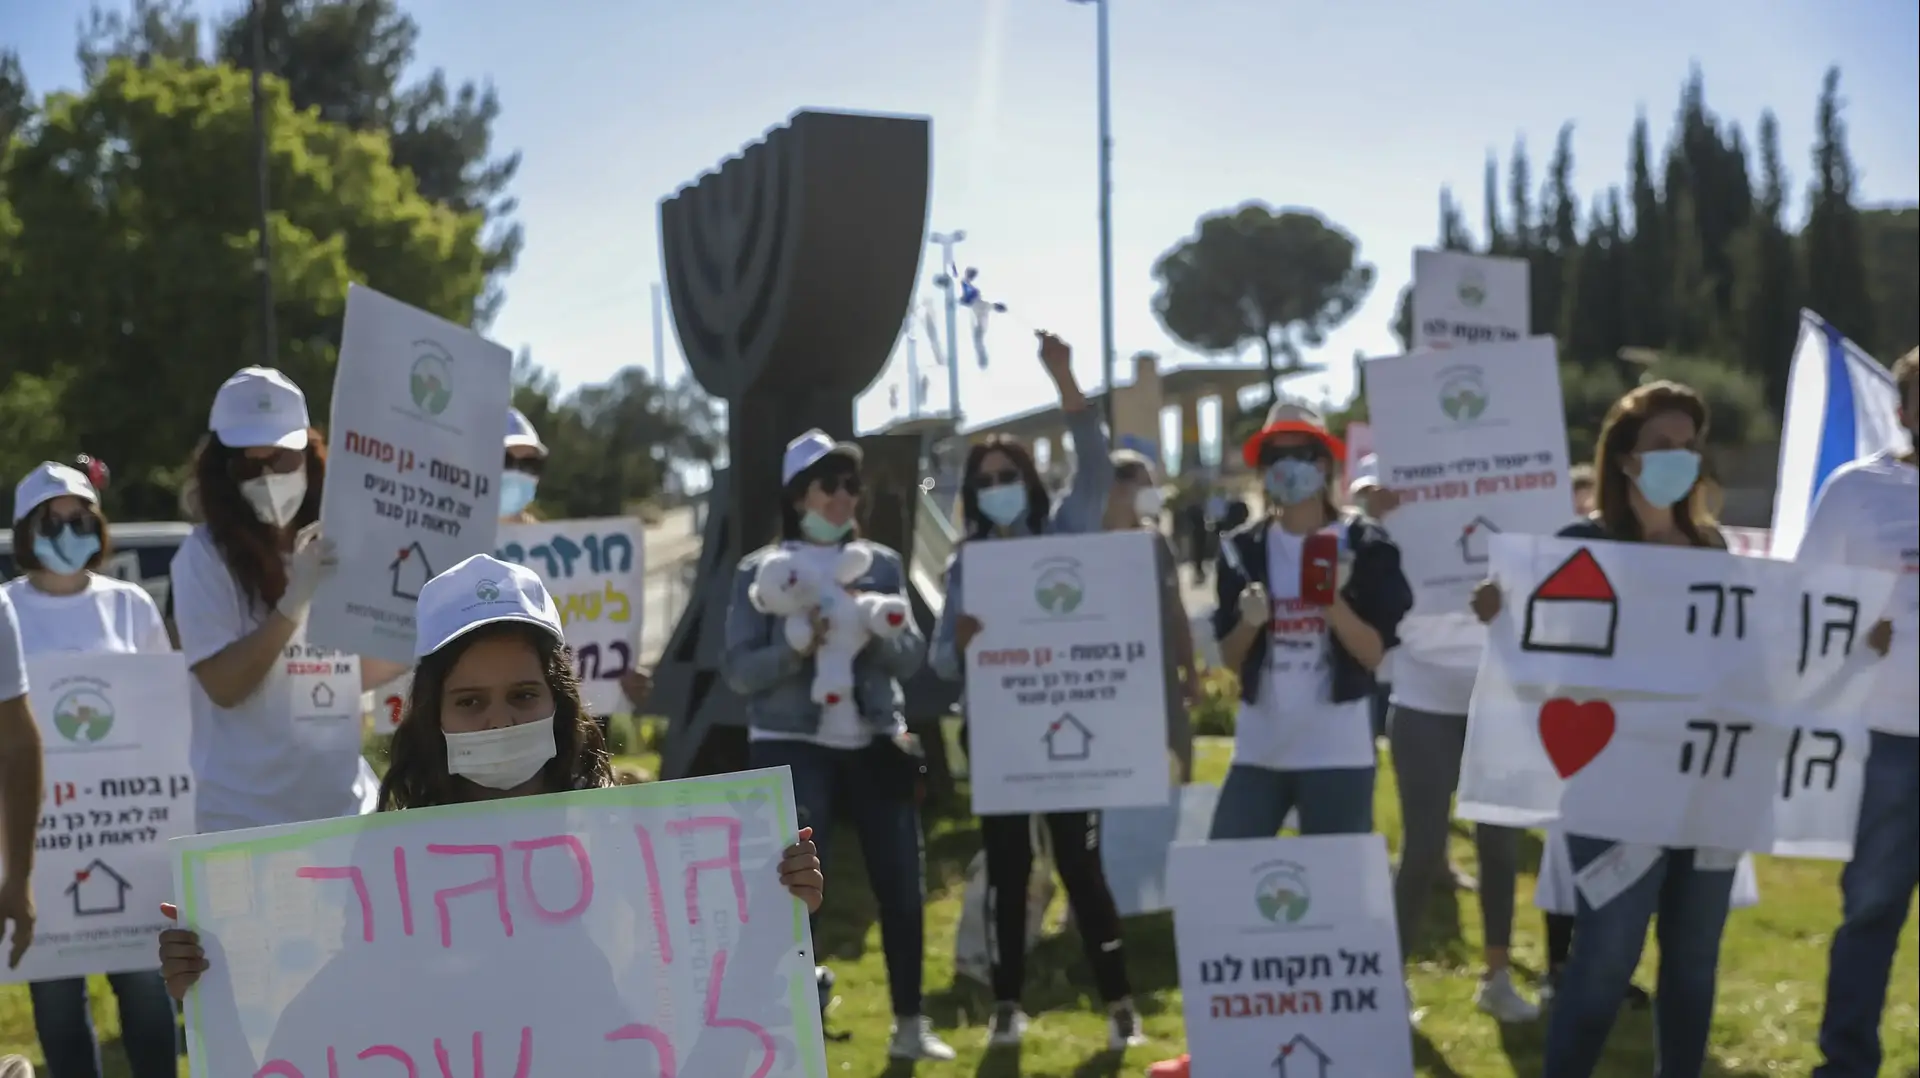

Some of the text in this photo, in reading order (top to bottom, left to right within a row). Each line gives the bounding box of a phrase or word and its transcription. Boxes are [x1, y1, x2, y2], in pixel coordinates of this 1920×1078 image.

[345, 429, 394, 463] פתוח
[397, 448, 414, 473] גן
[430, 458, 472, 490] בטוח
[474, 472, 489, 498] גן
[496, 533, 633, 578] חוזרי
[1688, 583, 1859, 677] גן זה
[1069, 643, 1123, 663] בטוח
[1680, 719, 1844, 800] גן זה
[54, 782, 77, 808] גן
[100, 775, 162, 800] בטוח
[169, 775, 191, 799] גן
[62, 810, 86, 833] כך
[89, 808, 113, 829] כל
[118, 804, 144, 825] לא
[148, 806, 169, 822] זה
[77, 832, 94, 853] גן
[99, 826, 157, 847] לראות
[295, 834, 595, 950] סגור
[633, 815, 749, 964] גן
[1200, 948, 1383, 988] אל תקחו לנו
[1209, 986, 1379, 1019] את האהבה
